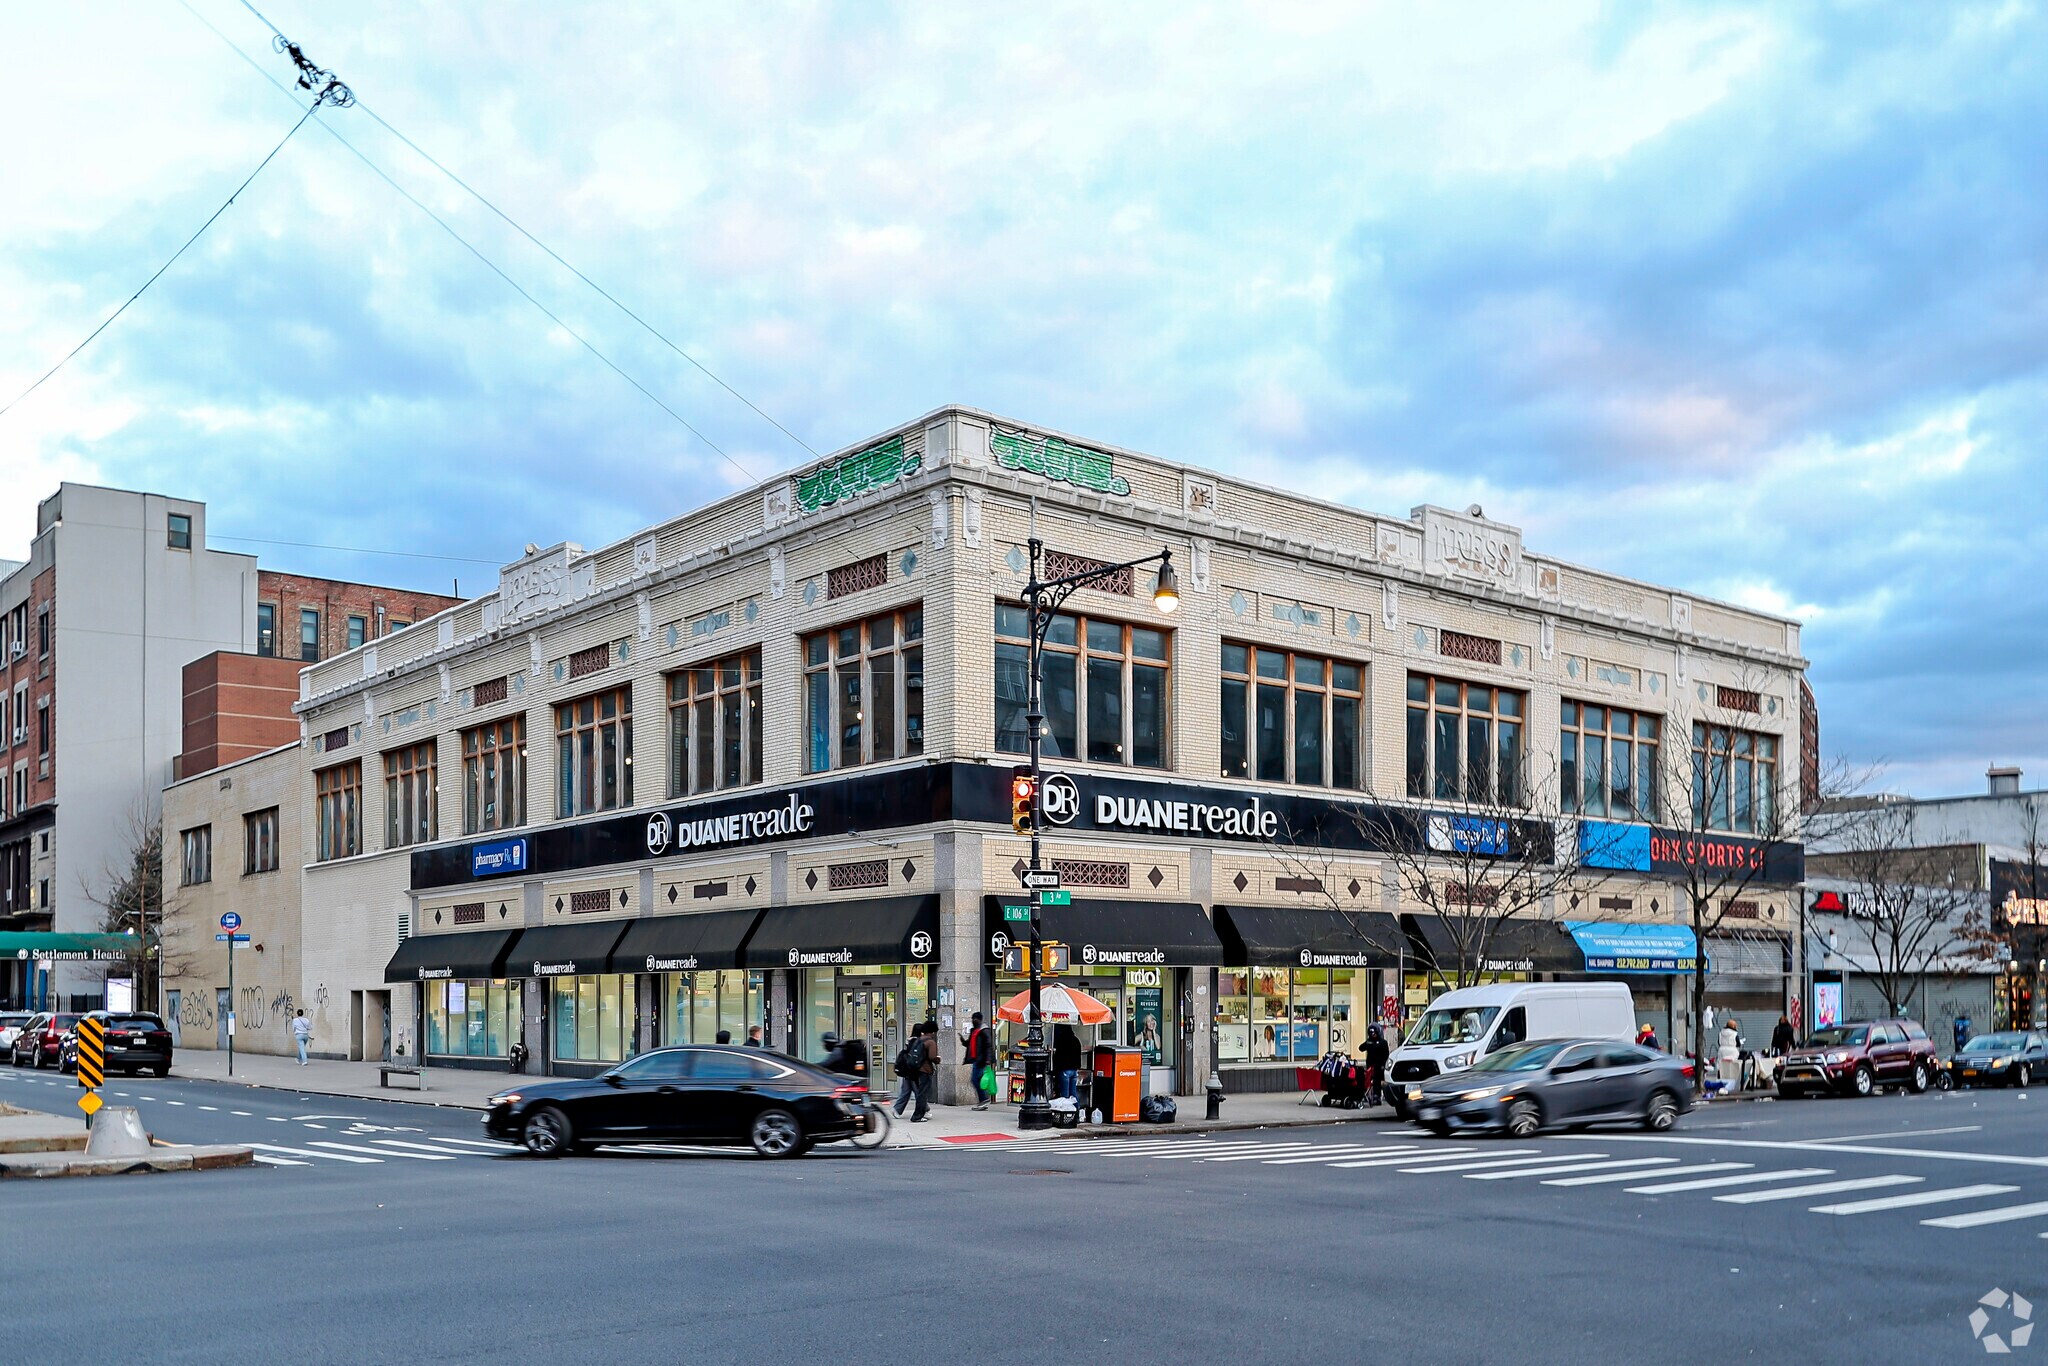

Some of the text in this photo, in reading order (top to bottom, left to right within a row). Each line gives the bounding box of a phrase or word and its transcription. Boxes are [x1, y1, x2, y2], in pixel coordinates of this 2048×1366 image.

[475, 851, 504, 869] pharmacy
[1043, 876, 1056, 884] WAY
[1049, 891, 1055, 903] 3
[1006, 909, 1011, 919] E
[1012, 909, 1022, 919] 106
[32, 949, 88, 960] Settlement
